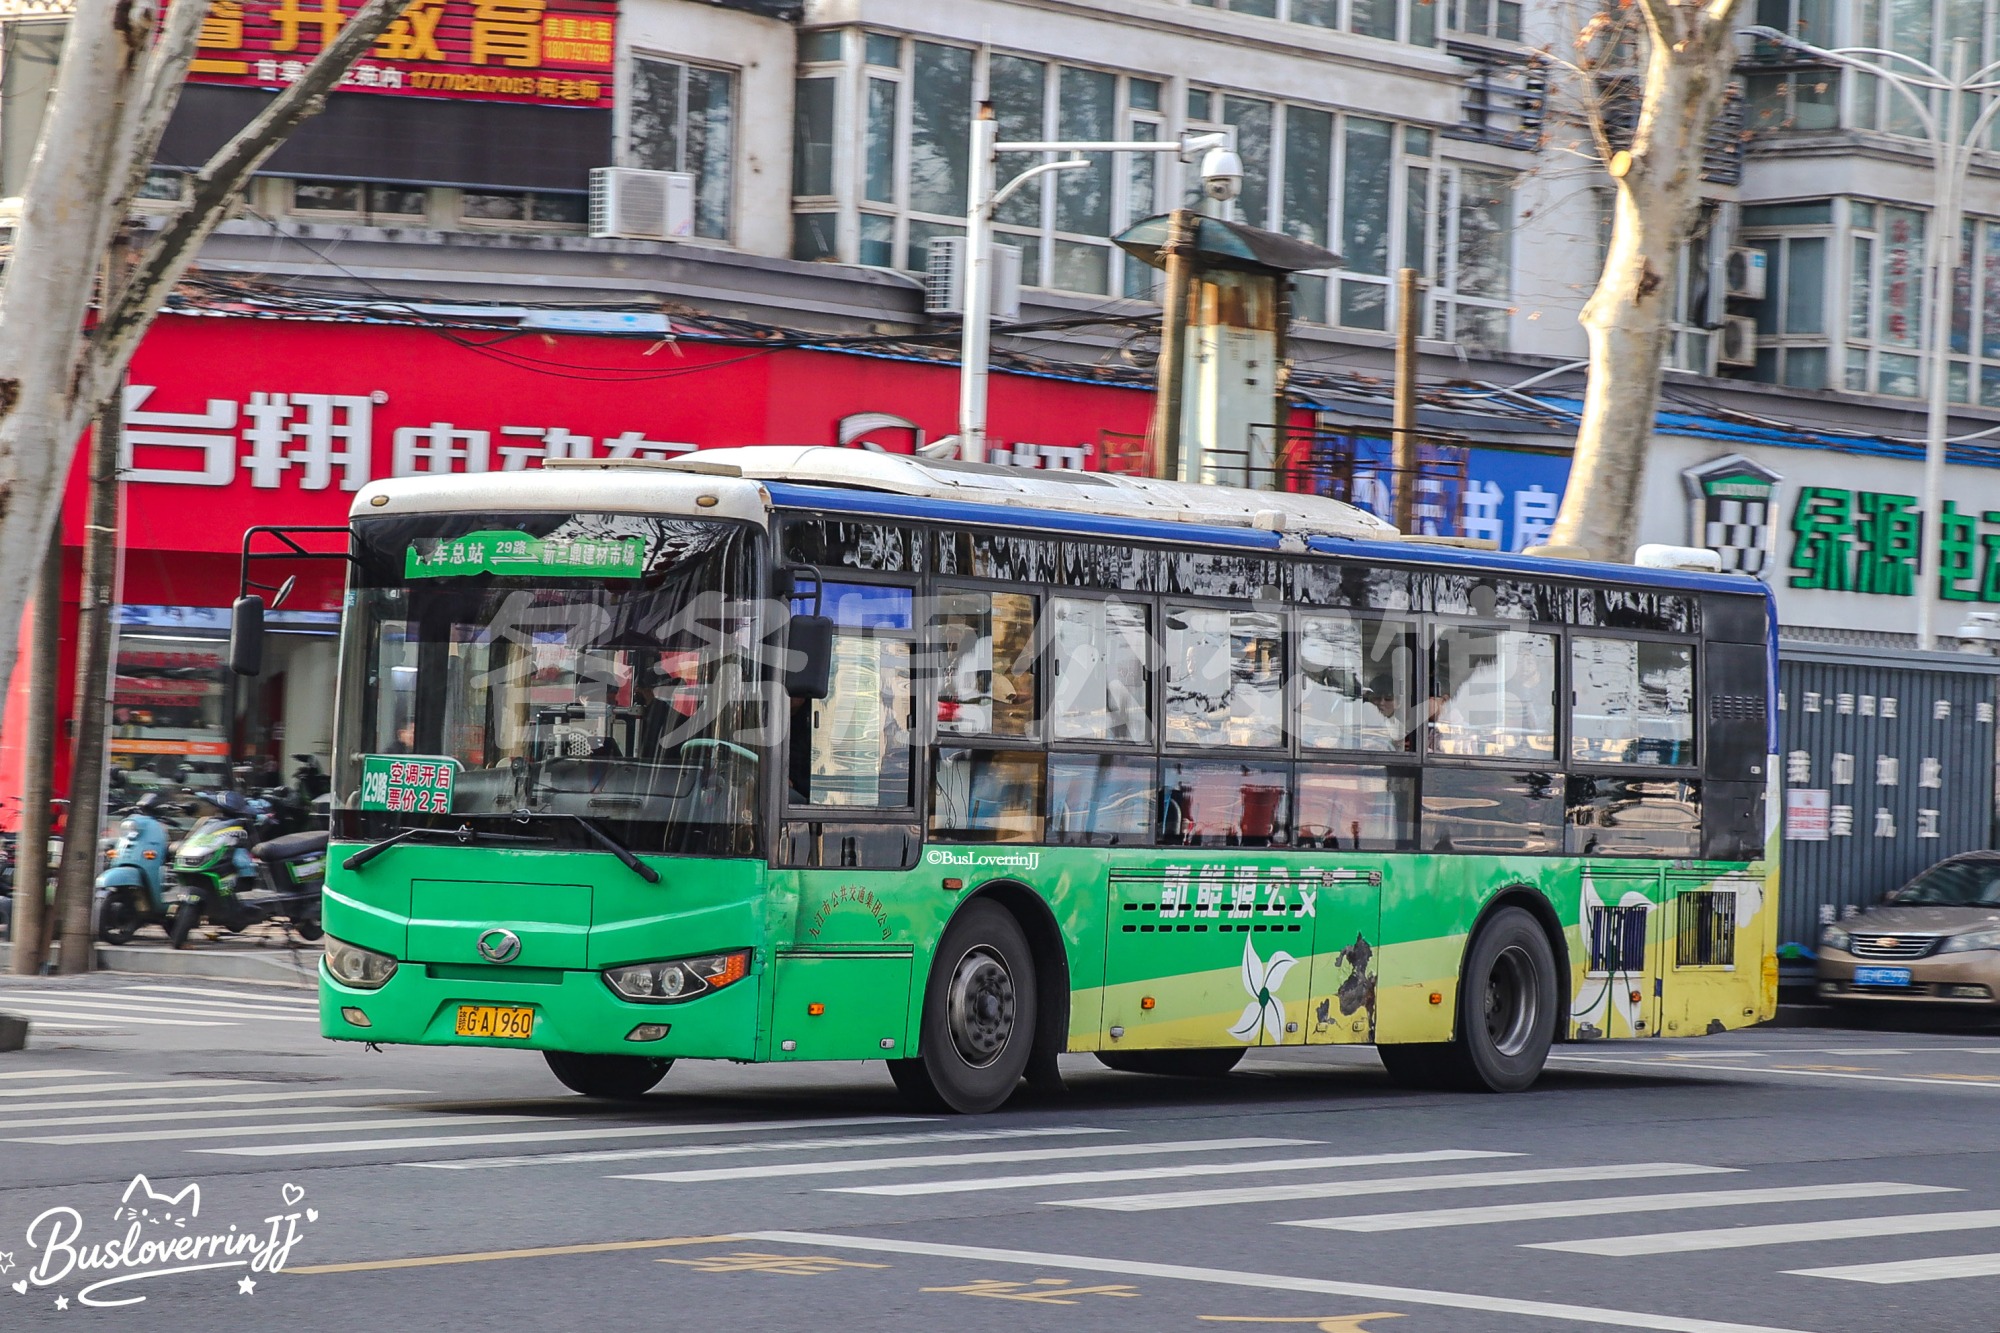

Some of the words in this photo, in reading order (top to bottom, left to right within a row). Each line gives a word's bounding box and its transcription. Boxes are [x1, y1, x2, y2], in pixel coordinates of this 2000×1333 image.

[496, 540, 527, 555] 29路
[389, 762, 452, 790] 空调开启
[386, 786, 447, 814] 票价2元
[808, 884, 893, 941] 九江市公共交通集团公司
